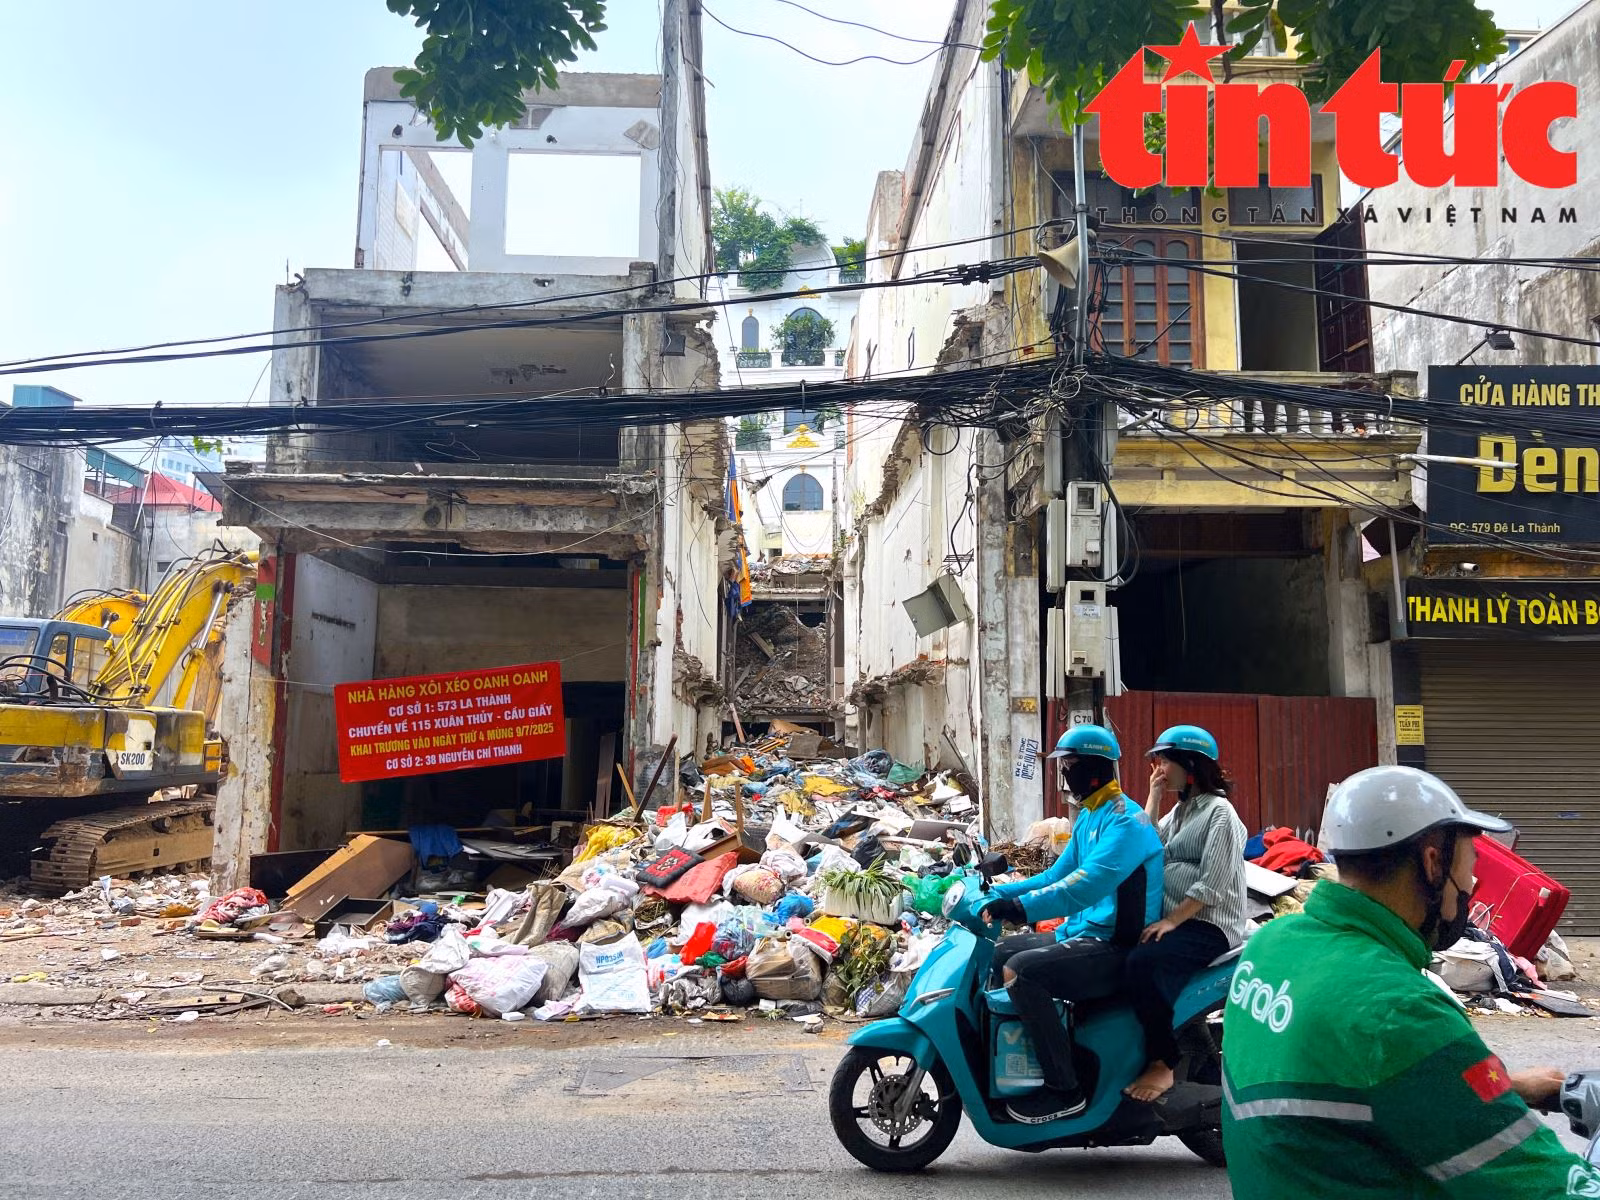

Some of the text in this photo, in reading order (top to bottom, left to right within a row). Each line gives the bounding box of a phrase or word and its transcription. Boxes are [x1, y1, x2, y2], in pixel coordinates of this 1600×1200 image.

[1460, 375, 1505, 406] CỬA
[1512, 379, 1571, 406] HÀNG
[1472, 523, 1491, 533] 579
[1494, 523, 1509, 533] Đê
[1511, 523, 1525, 533] La
[1527, 523, 1561, 533] Thành
[1407, 592, 1600, 625] THANH LÝ TOÀN B
[348, 670, 549, 704] NHÀ HÀNG XÔI XÉO OANH OANH
[437, 700, 458, 712] 573
[460, 698, 474, 709] LA
[475, 693, 513, 708] THÀNH
[411, 720, 431, 732] 115
[433, 714, 465, 729] XUÂN
[350, 744, 373, 757] KHAI
[412, 736, 431, 749] VÀO
[432, 732, 457, 747] NGÀY
[425, 754, 437, 766] 38
[493, 743, 523, 758] THANH
[120, 752, 146, 765] SK200
[1230, 960, 1293, 1033] Grab
